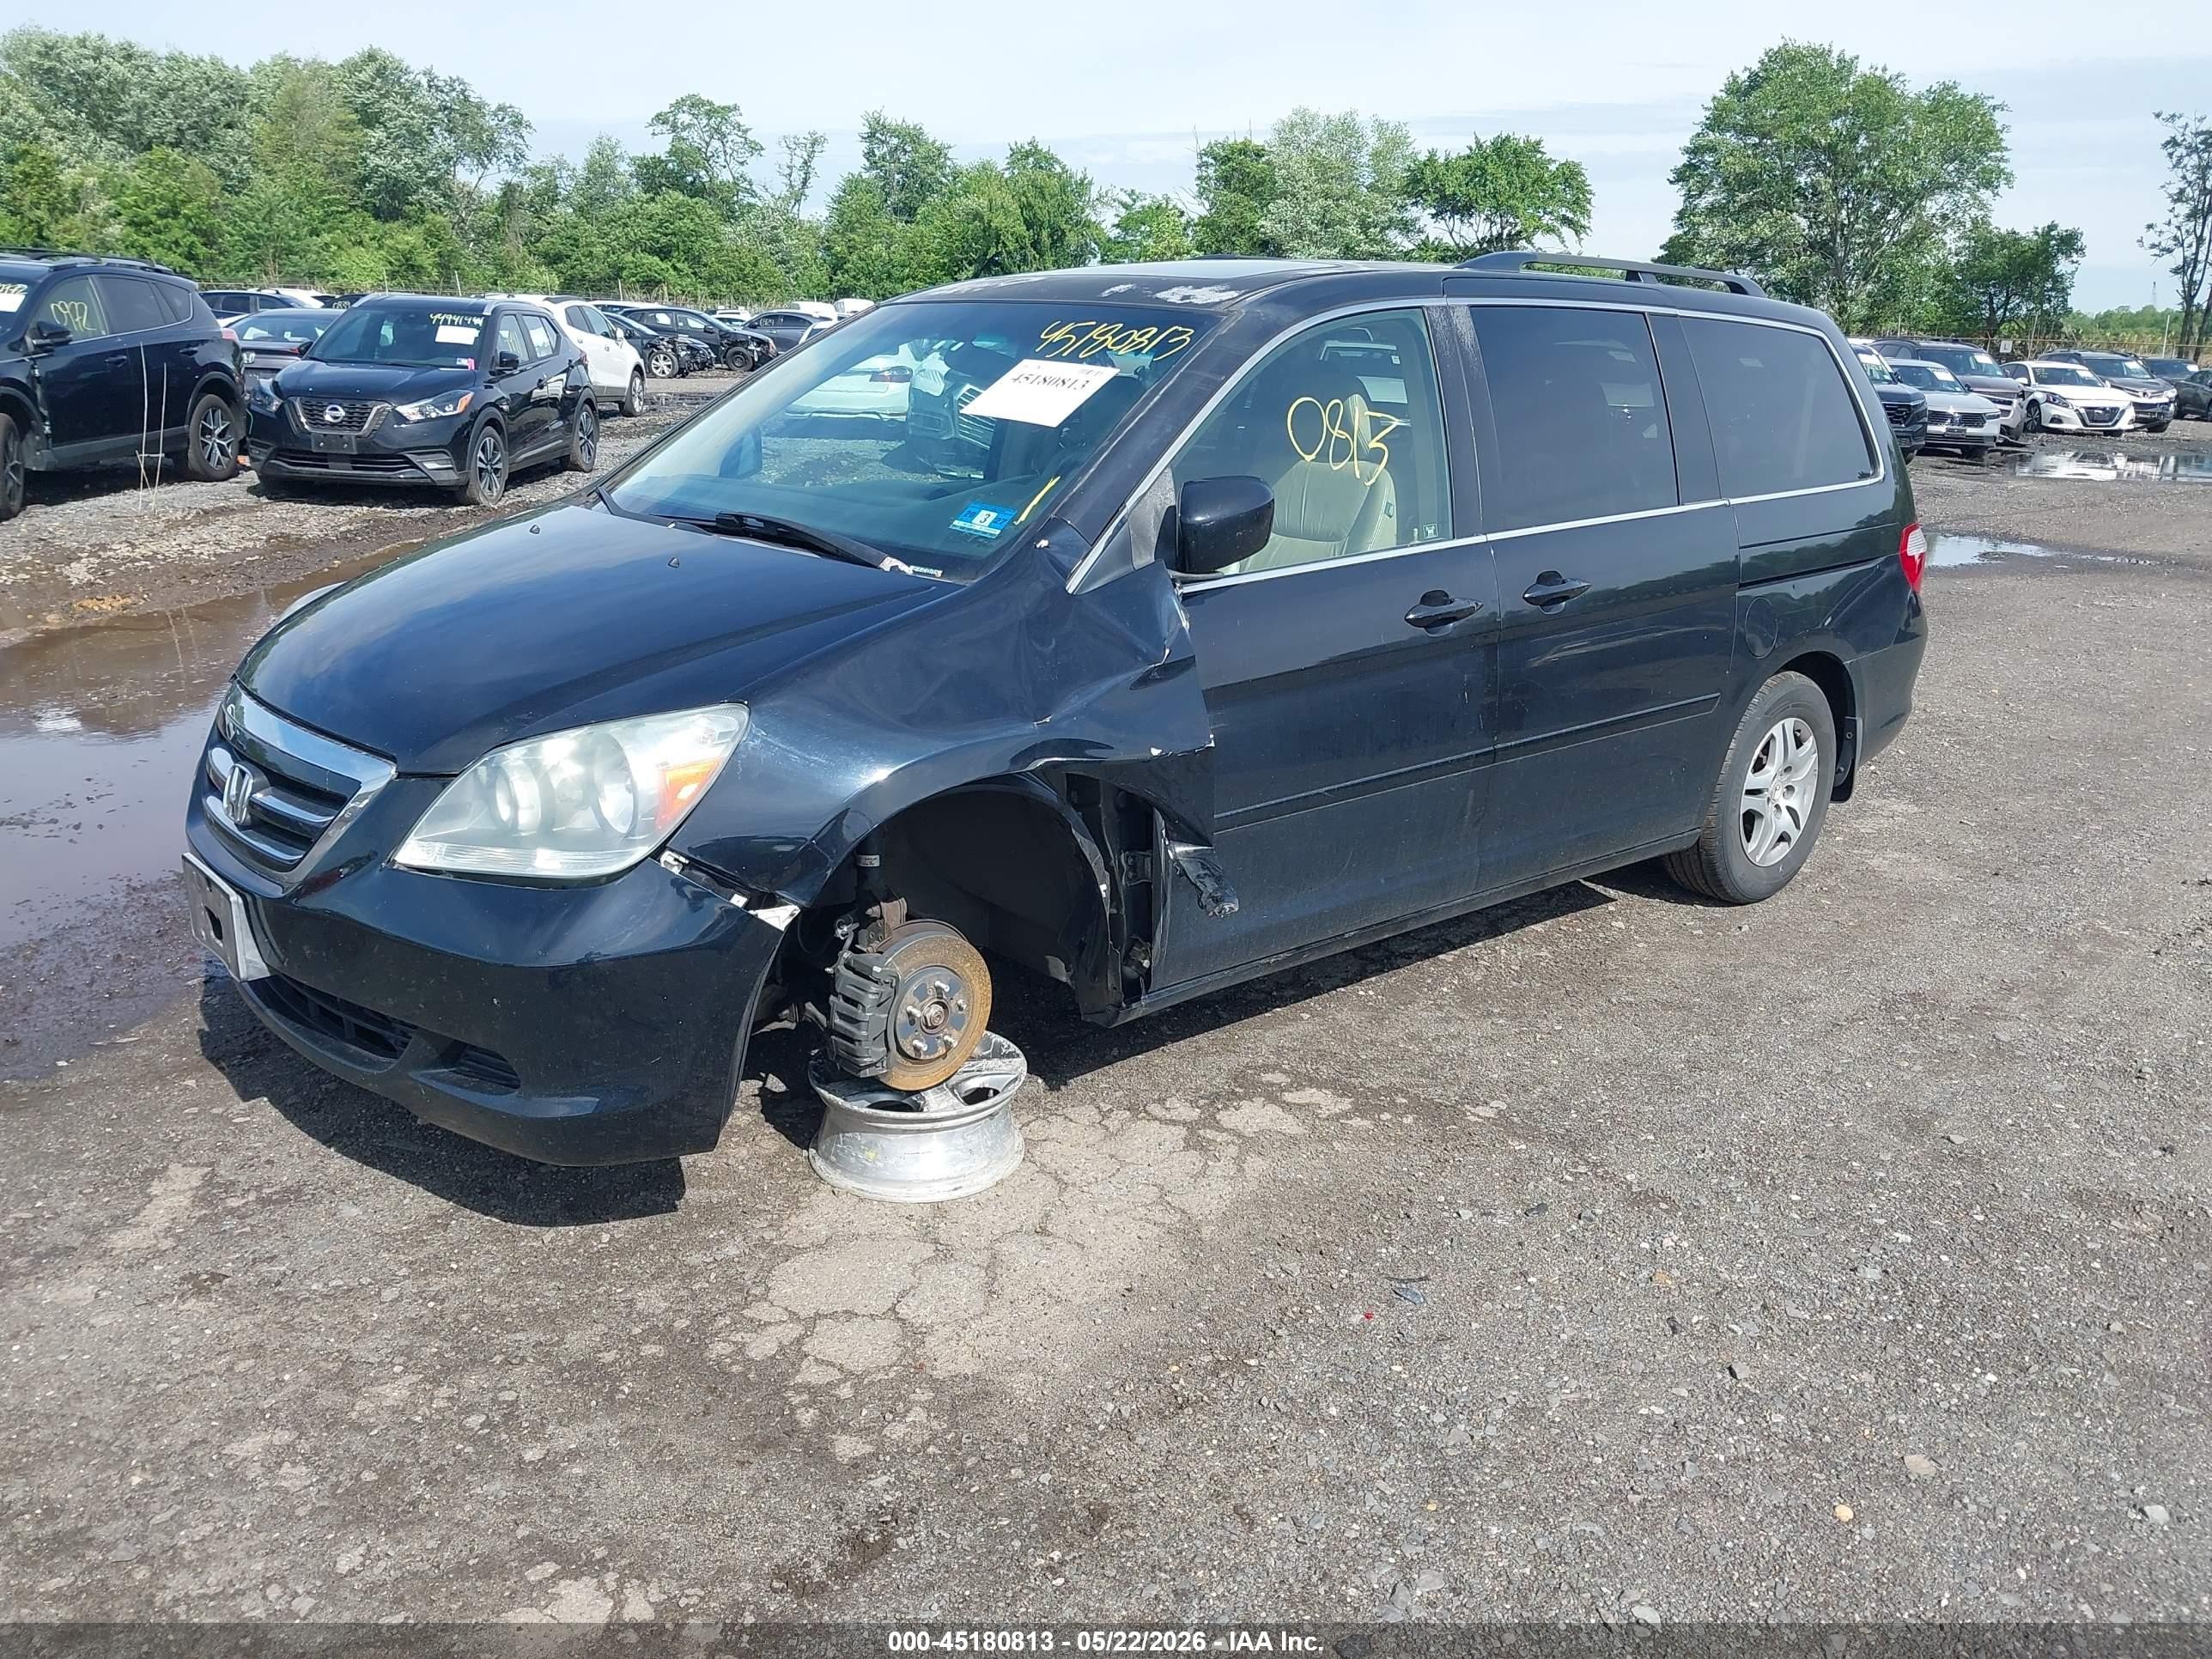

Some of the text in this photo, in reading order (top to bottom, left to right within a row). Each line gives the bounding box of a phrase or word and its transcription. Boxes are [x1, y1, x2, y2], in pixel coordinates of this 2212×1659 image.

[1036, 321, 1194, 361] 45180813
[1286, 396, 1403, 486] 0813
[980, 514, 991, 524] 3
